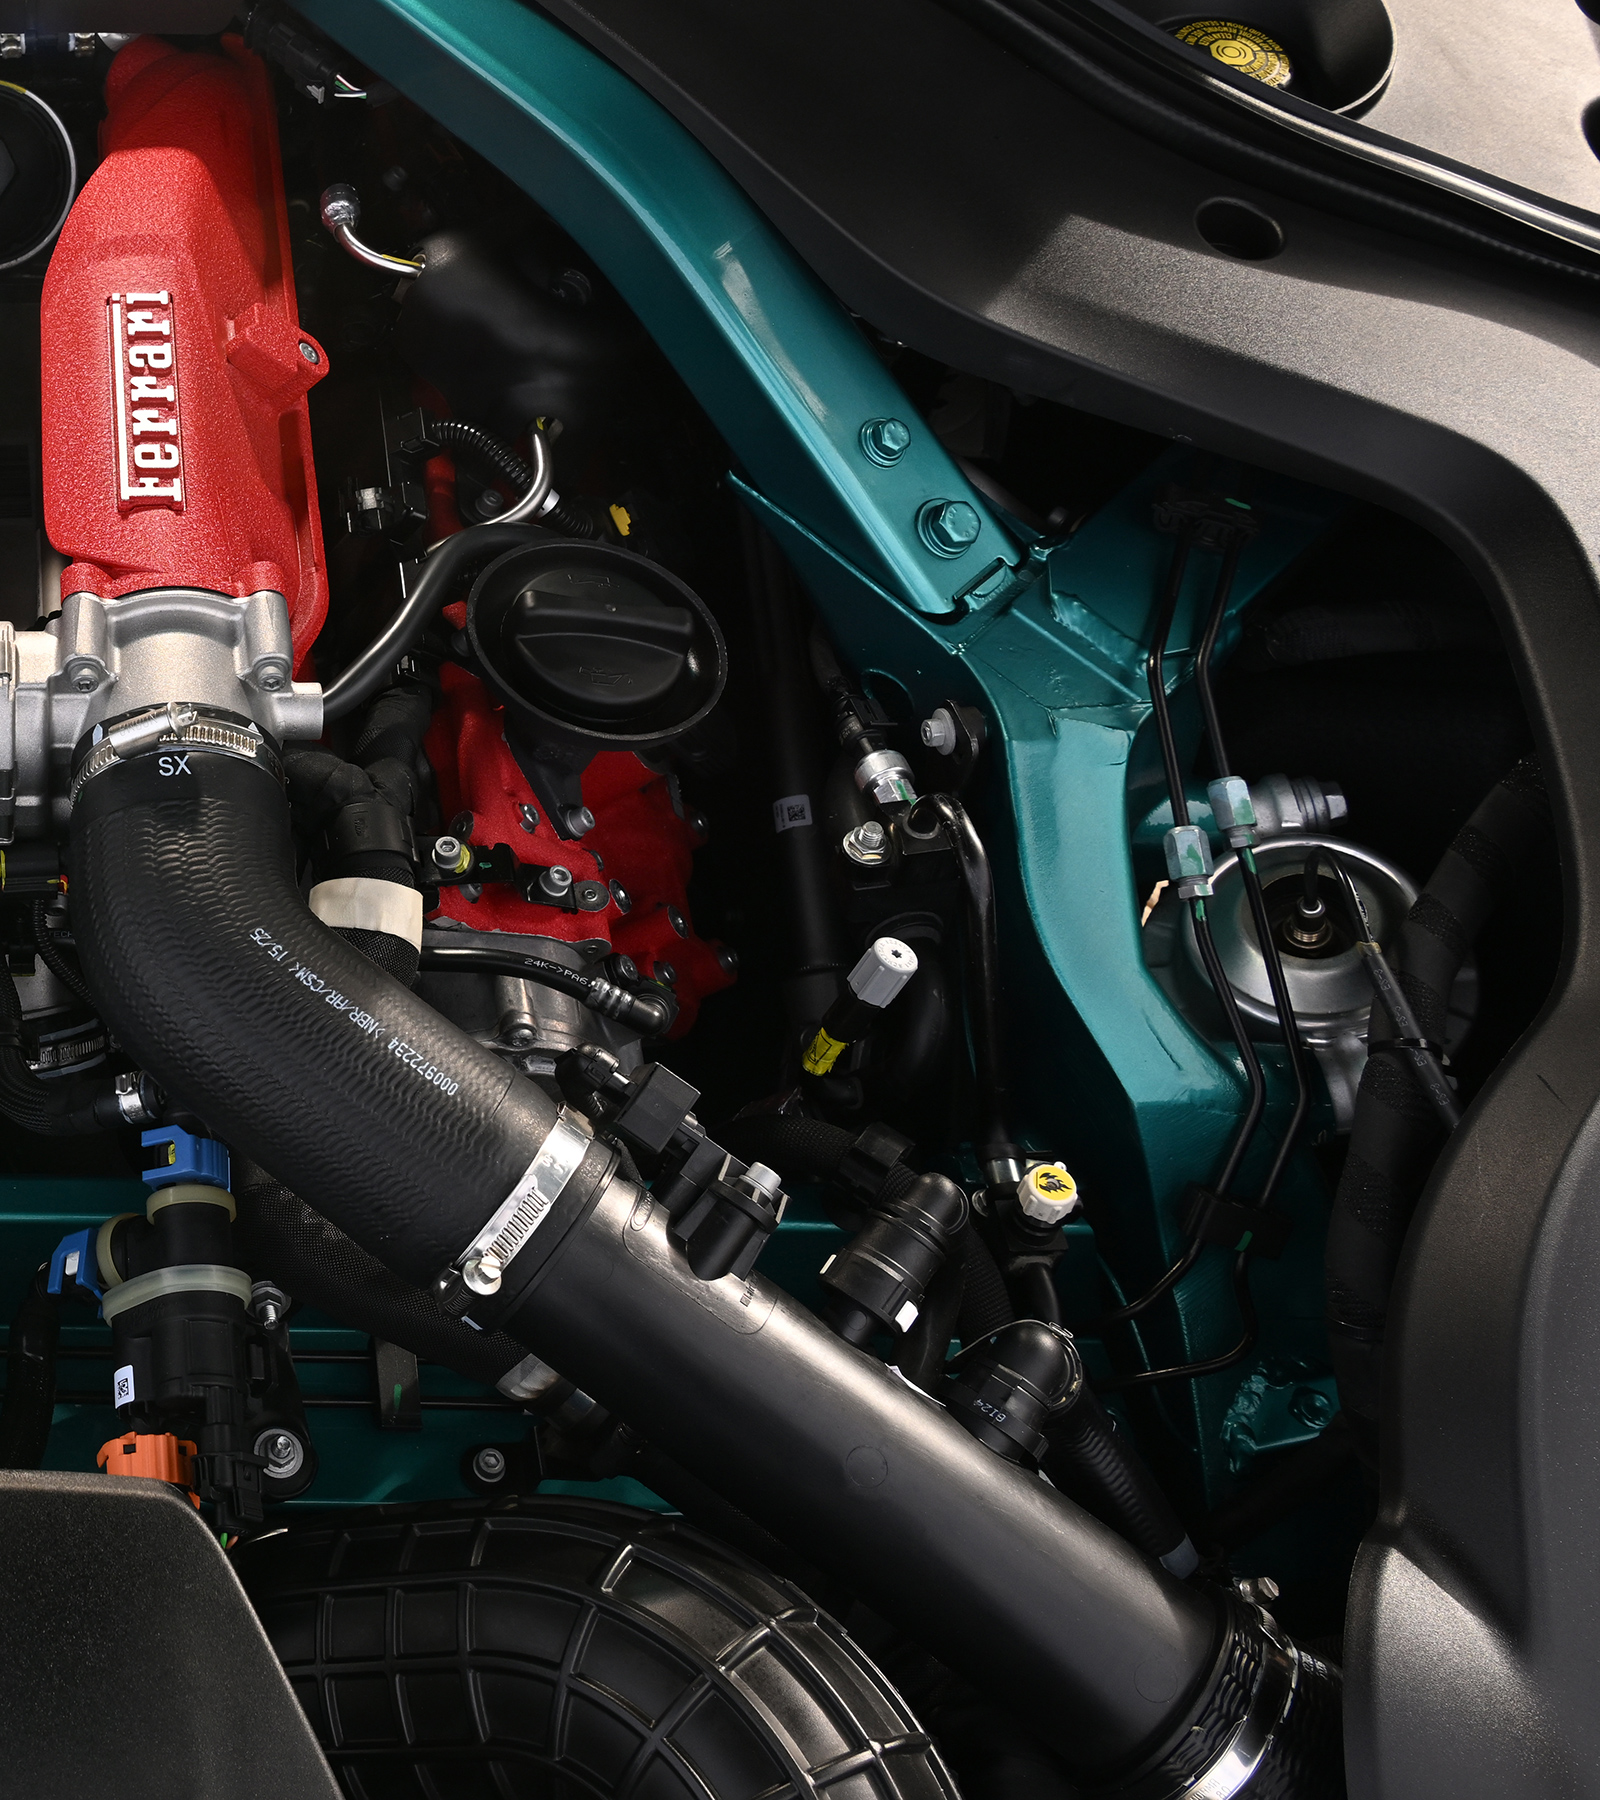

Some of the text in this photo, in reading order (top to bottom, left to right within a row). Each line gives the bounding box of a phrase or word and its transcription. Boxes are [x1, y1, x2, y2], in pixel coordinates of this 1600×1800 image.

[106, 289, 186, 512] Ferrari
[158, 755, 192, 776] SX
[250, 927, 458, 1096] 000972234 >NBR/AR/CSM< 15/25
